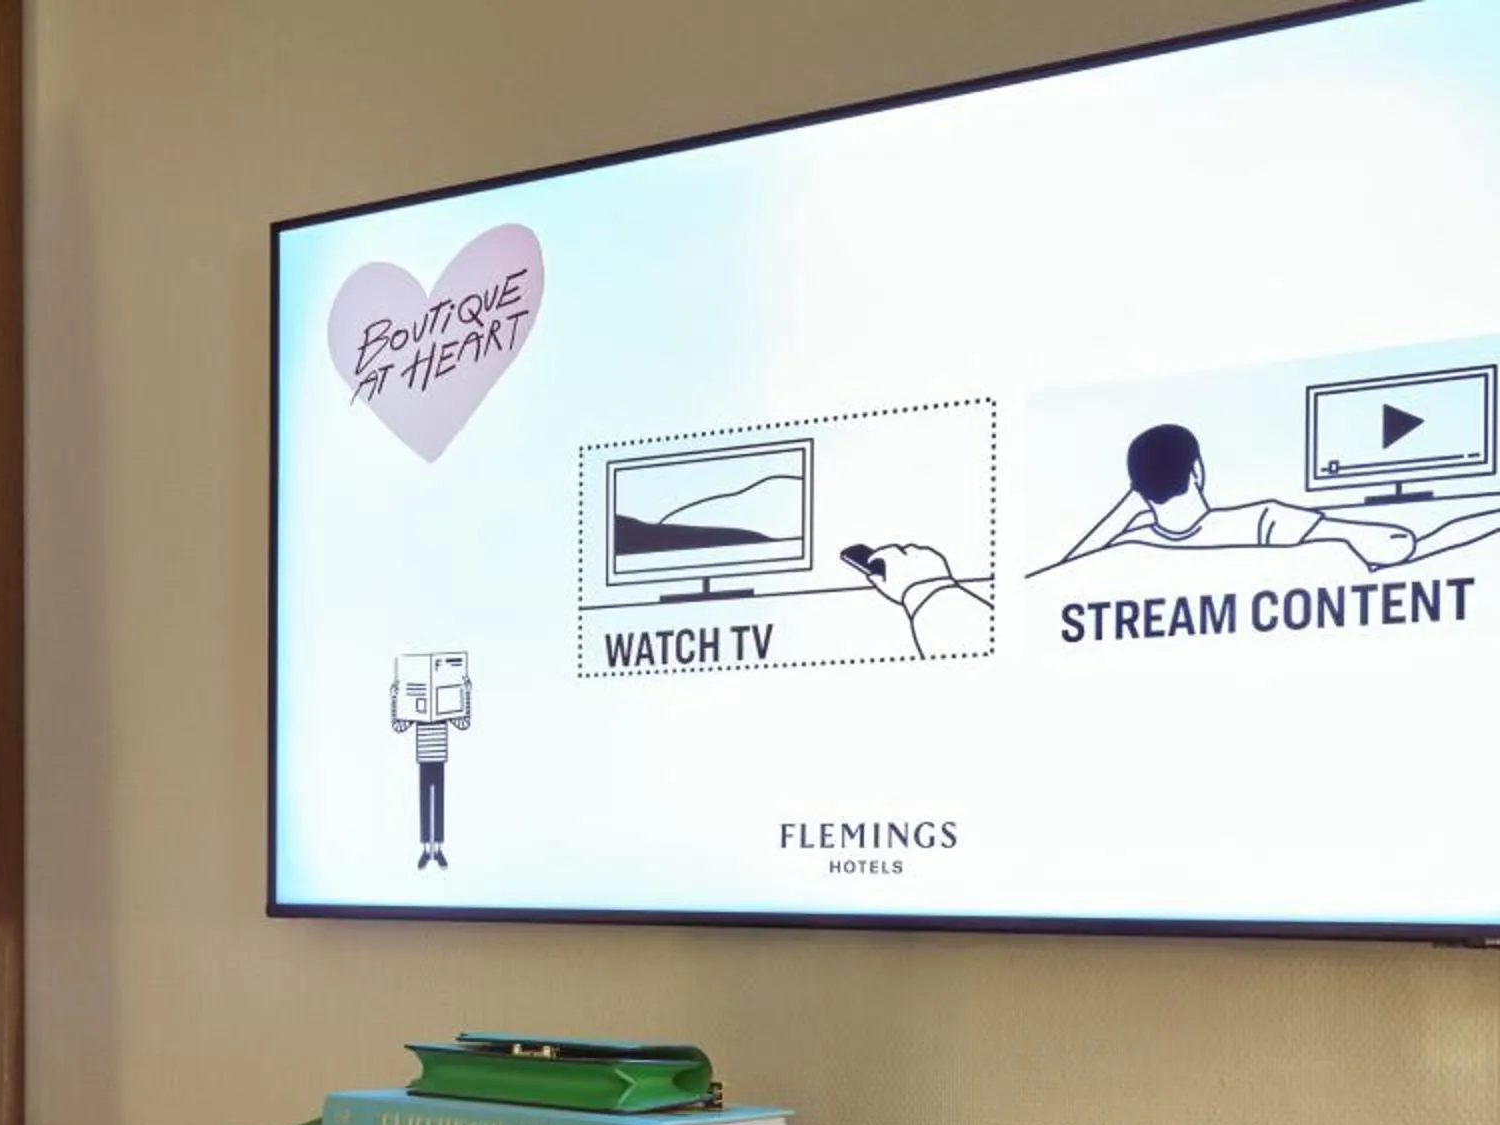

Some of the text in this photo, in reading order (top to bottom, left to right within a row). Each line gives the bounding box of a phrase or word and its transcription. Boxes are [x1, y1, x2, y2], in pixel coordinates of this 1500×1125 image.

[350, 310, 529, 406] AT HEART
[1061, 577, 1476, 643] STREAM CONTENT
[605, 623, 774, 668] WATCH TV
[780, 821, 958, 849] FLEMINGS
[829, 859, 904, 875] HOTELS
